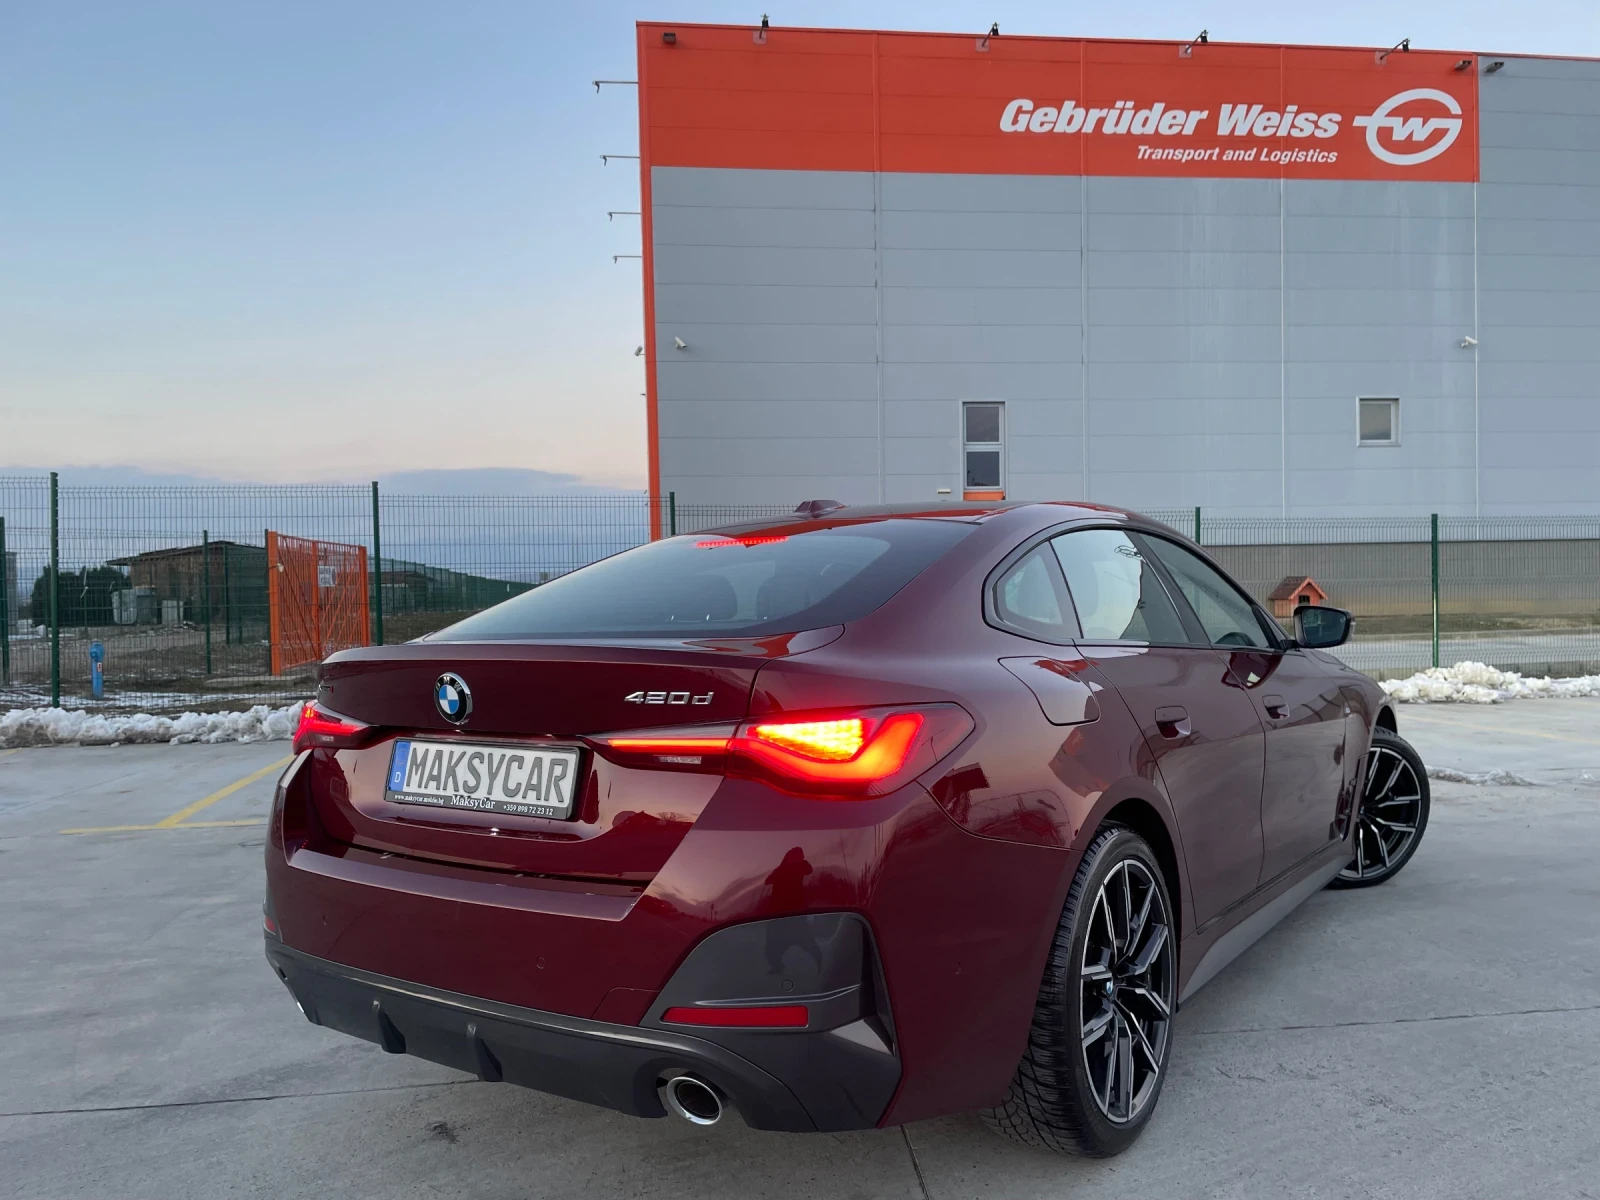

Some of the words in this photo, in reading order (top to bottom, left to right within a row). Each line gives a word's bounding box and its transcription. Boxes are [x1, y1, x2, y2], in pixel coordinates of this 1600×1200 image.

[1000, 98, 1208, 136] Gebrüder
[1217, 103, 1341, 138] Weiss
[1136, 145, 1219, 163] Transport
[1223, 147, 1256, 162] and
[1260, 147, 1338, 164] Logistics
[394, 772, 401, 783] D
[406, 747, 569, 803] MAKSYCAR
[450, 795, 496, 809] MaksyCar
[503, 804, 517, 812] +359
[545, 808, 554, 816] 12
